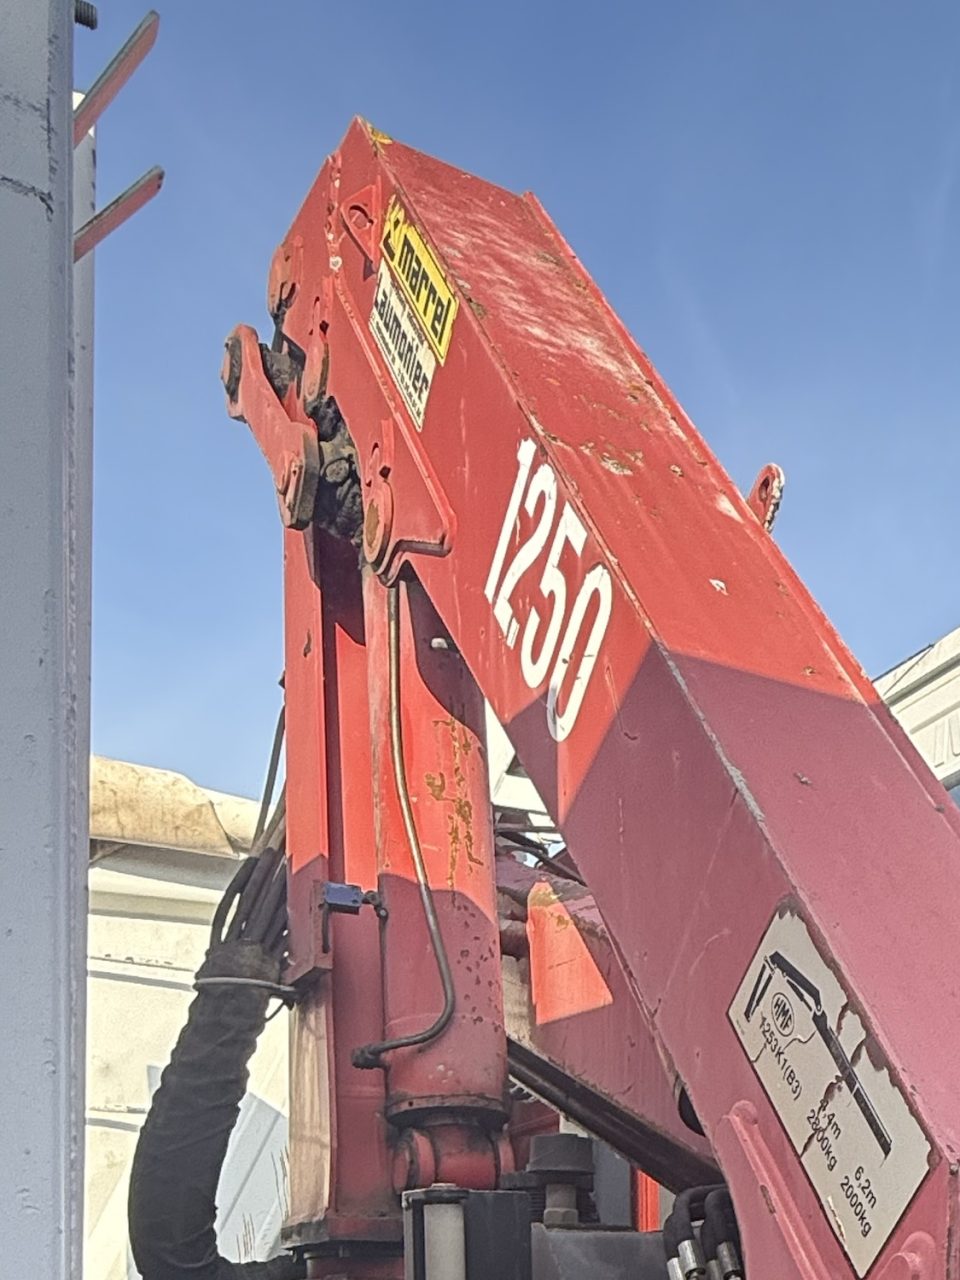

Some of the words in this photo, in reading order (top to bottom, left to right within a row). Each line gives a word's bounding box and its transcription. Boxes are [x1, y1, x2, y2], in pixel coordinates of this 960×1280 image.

[399, 233, 451, 346] marrel
[484, 436, 612, 742] 1250
[772, 996, 793, 1032] HMF
[840, 1175, 873, 1238] 2000kg
[854, 1166, 878, 1209] 6,2m
